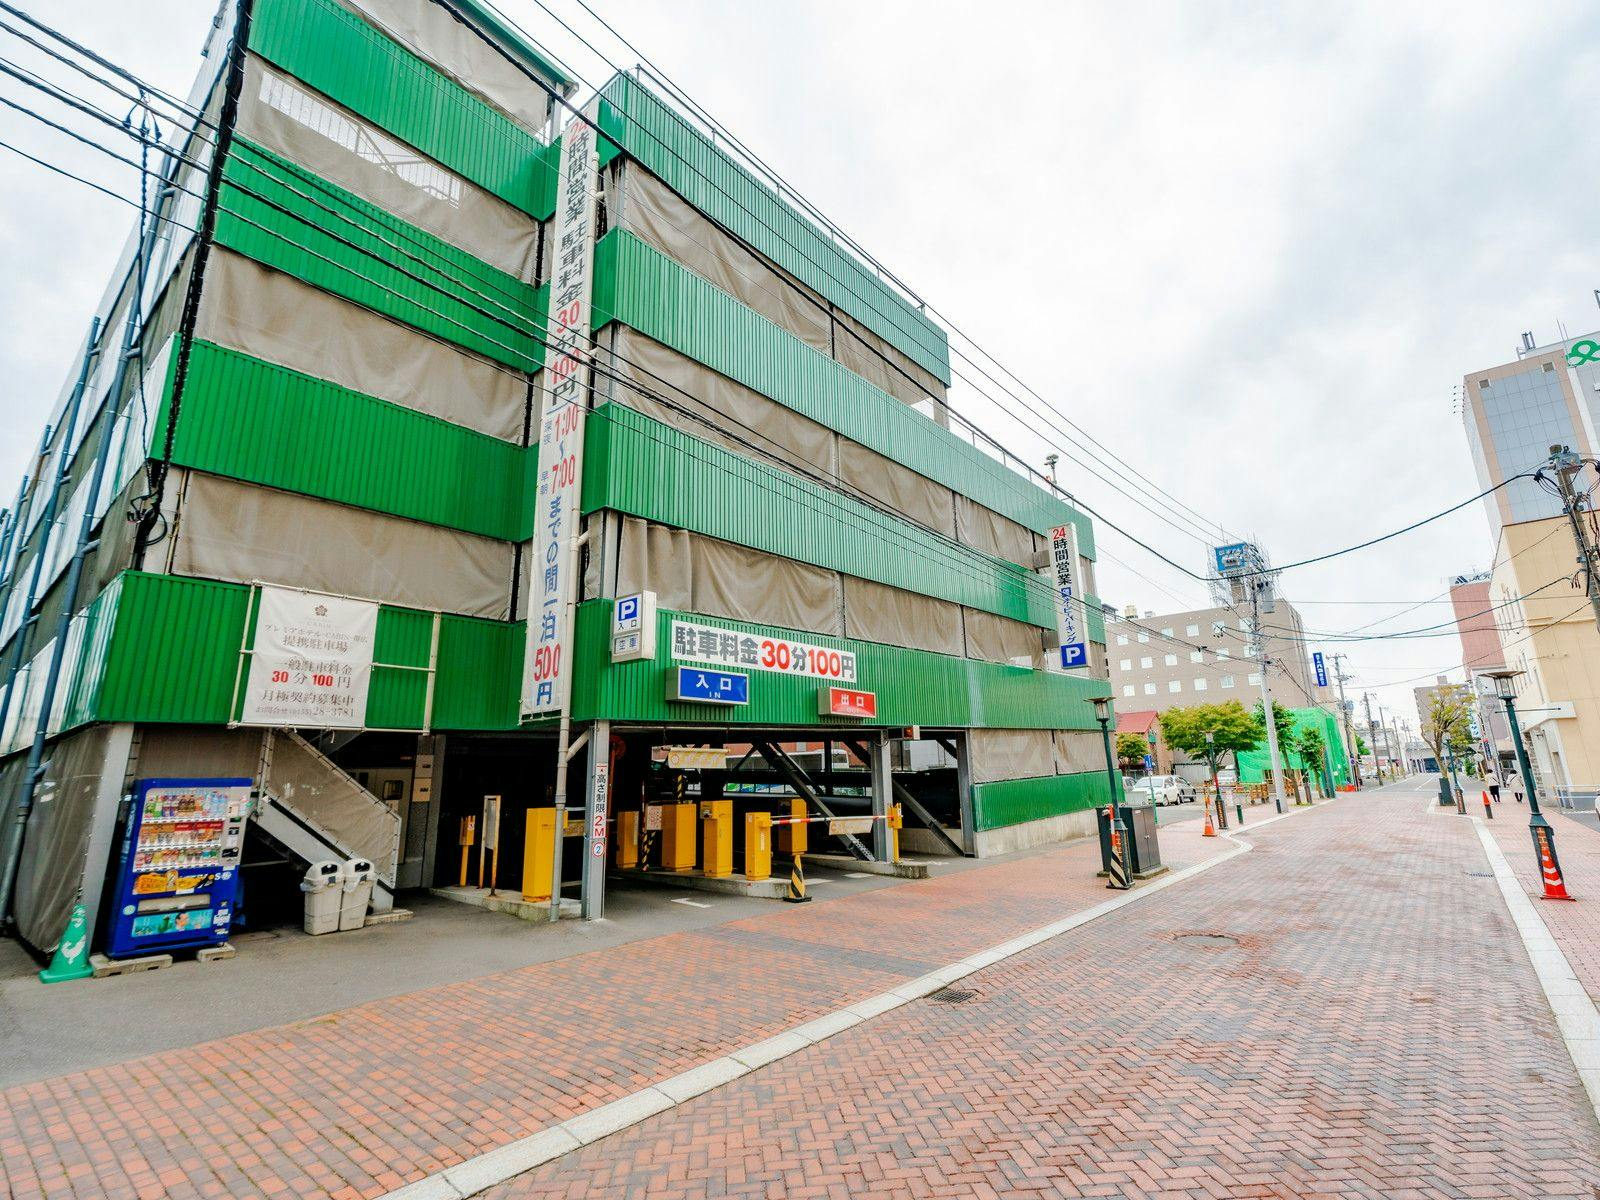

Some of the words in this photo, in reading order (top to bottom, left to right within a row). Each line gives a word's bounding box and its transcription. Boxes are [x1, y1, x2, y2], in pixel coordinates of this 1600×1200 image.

[1053, 527, 1072, 586] 24時間営業
[620, 600, 635, 620] P
[674, 626, 855, 679] 駐車料金30分100円
[1065, 647, 1081, 664] P
[696, 674, 732, 691] 入口
[709, 691, 722, 699] IN
[841, 694, 864, 707] 出口
